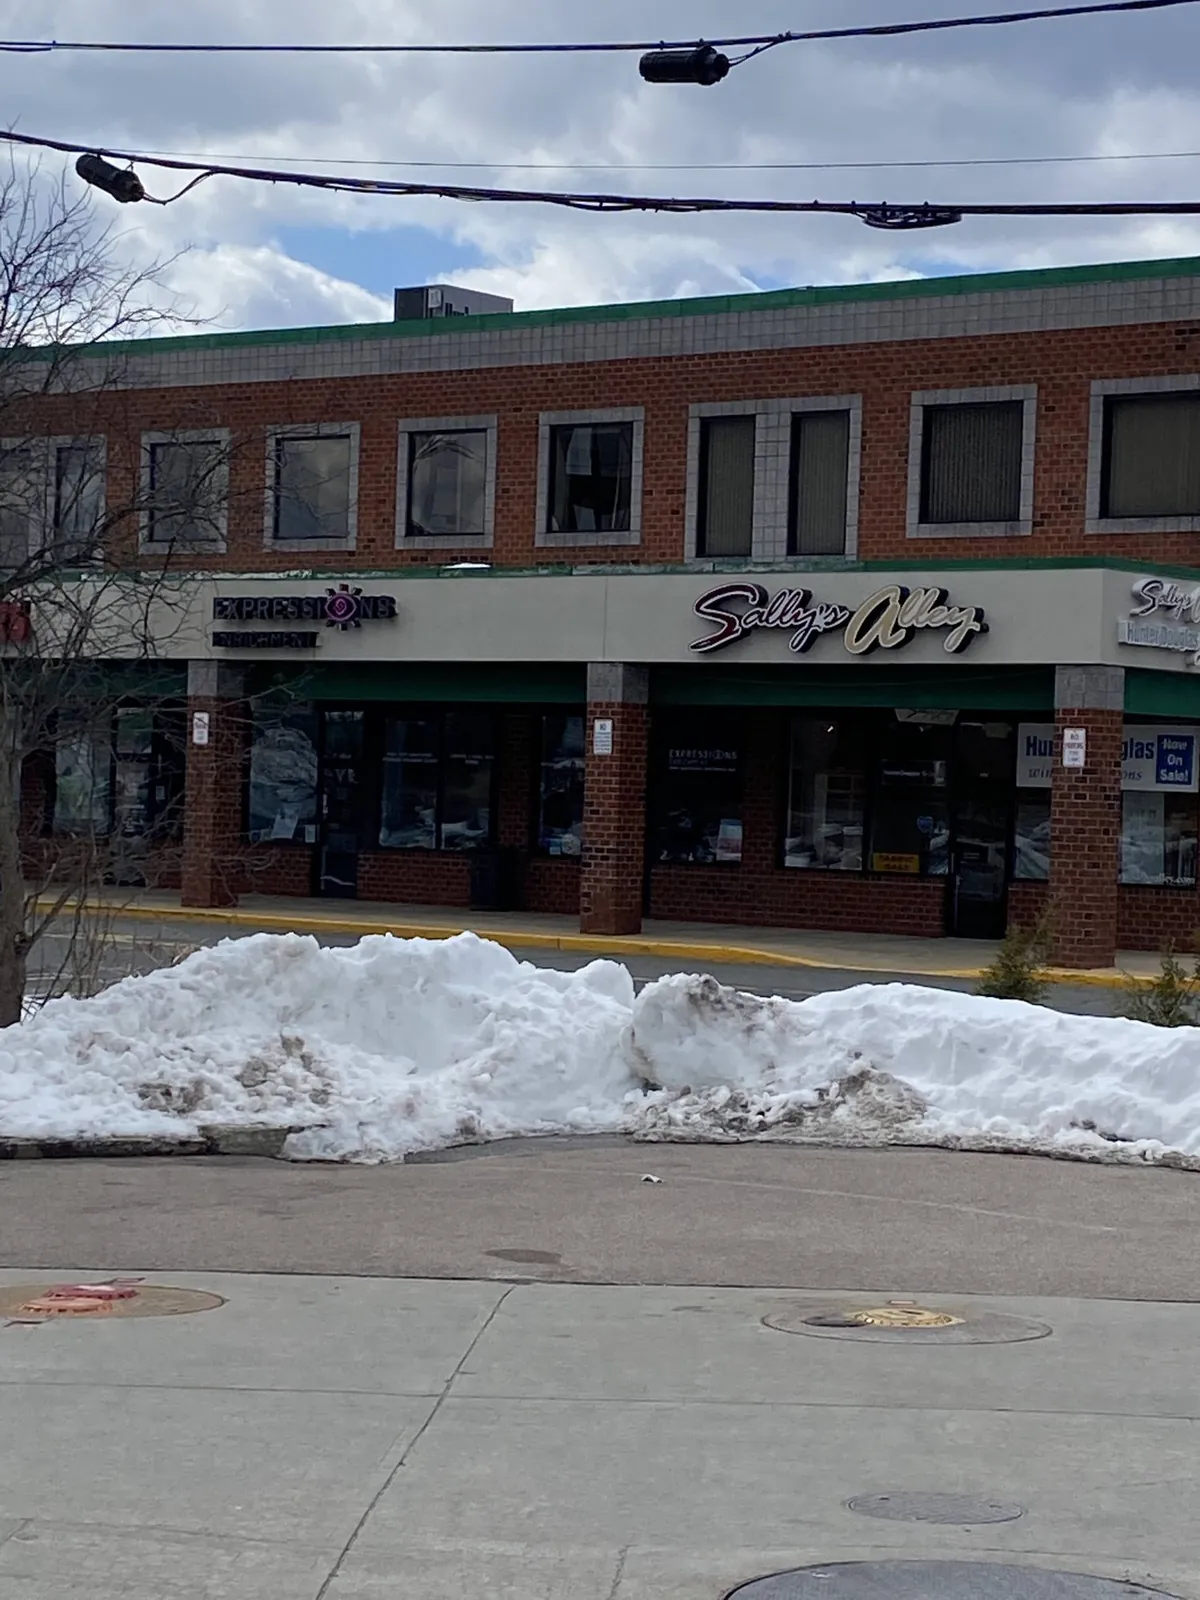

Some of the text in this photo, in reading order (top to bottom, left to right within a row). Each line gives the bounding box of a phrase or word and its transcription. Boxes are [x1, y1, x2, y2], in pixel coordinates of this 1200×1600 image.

[690, 582, 986, 654] Sally's Alley
[1161, 737, 1188, 750] Now
[1167, 753, 1183, 766] On
